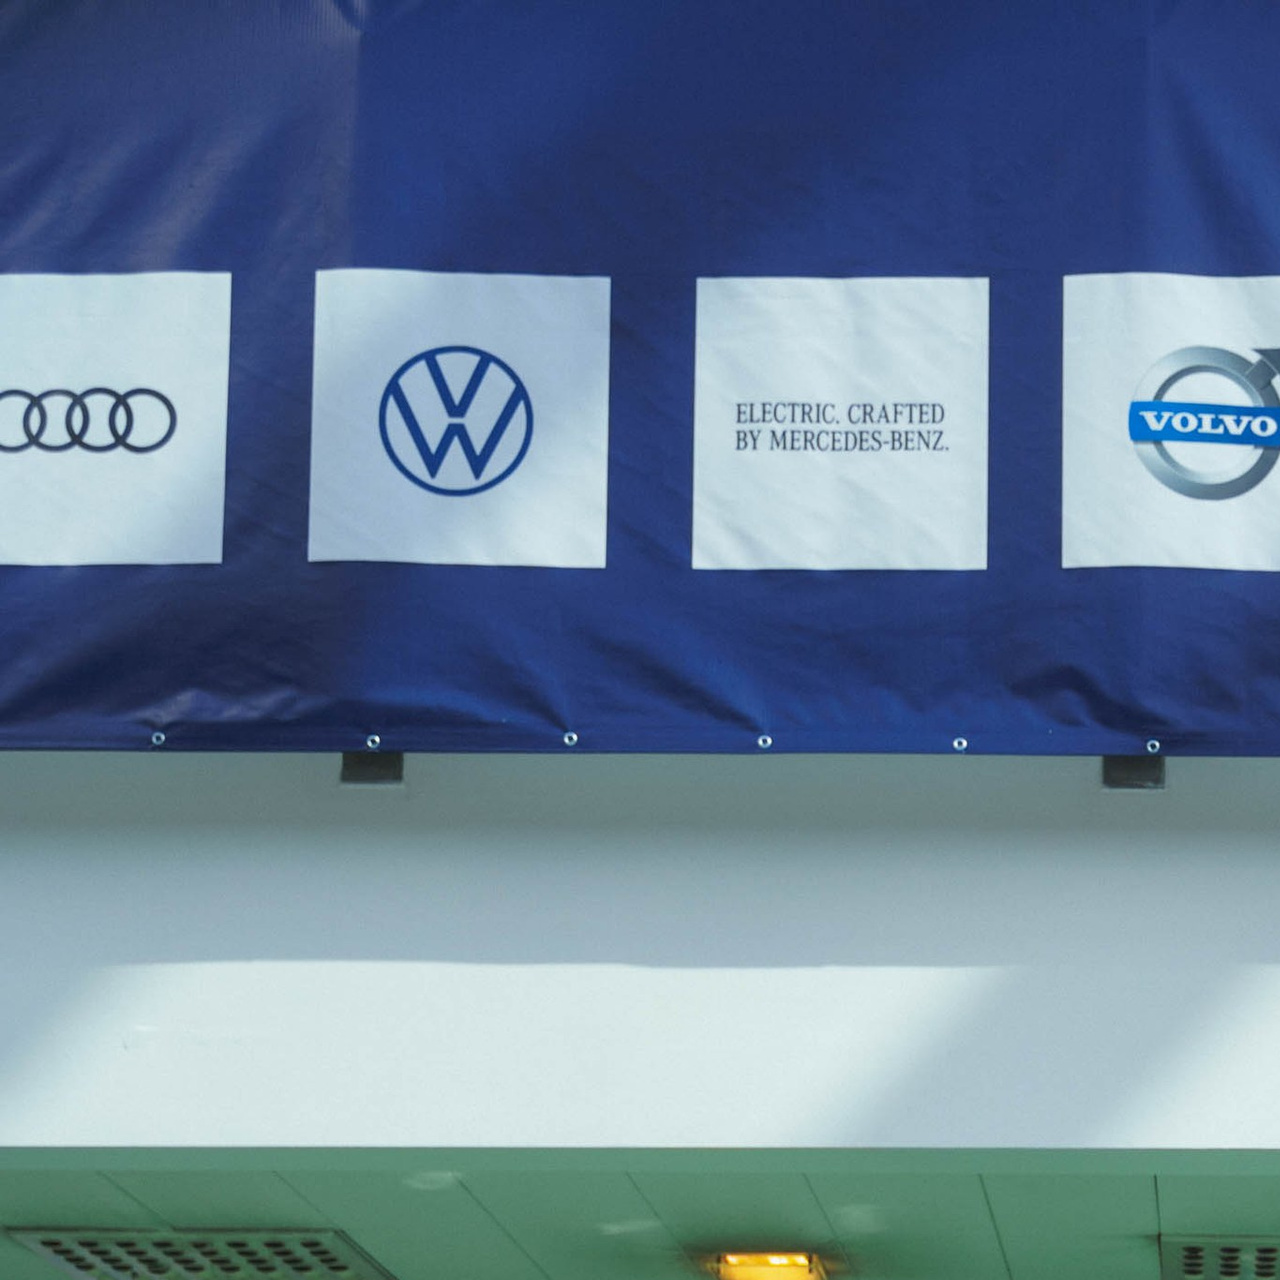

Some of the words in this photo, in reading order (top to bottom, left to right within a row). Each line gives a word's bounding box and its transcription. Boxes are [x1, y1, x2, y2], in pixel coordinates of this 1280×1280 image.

[735, 402, 840, 424] ELECTRIC.
[848, 403, 945, 425] CRAFTED
[1139, 411, 1278, 437] VOLVO
[735, 429, 762, 451] BY
[770, 430, 949, 452] MERCEDES-BENZ.
